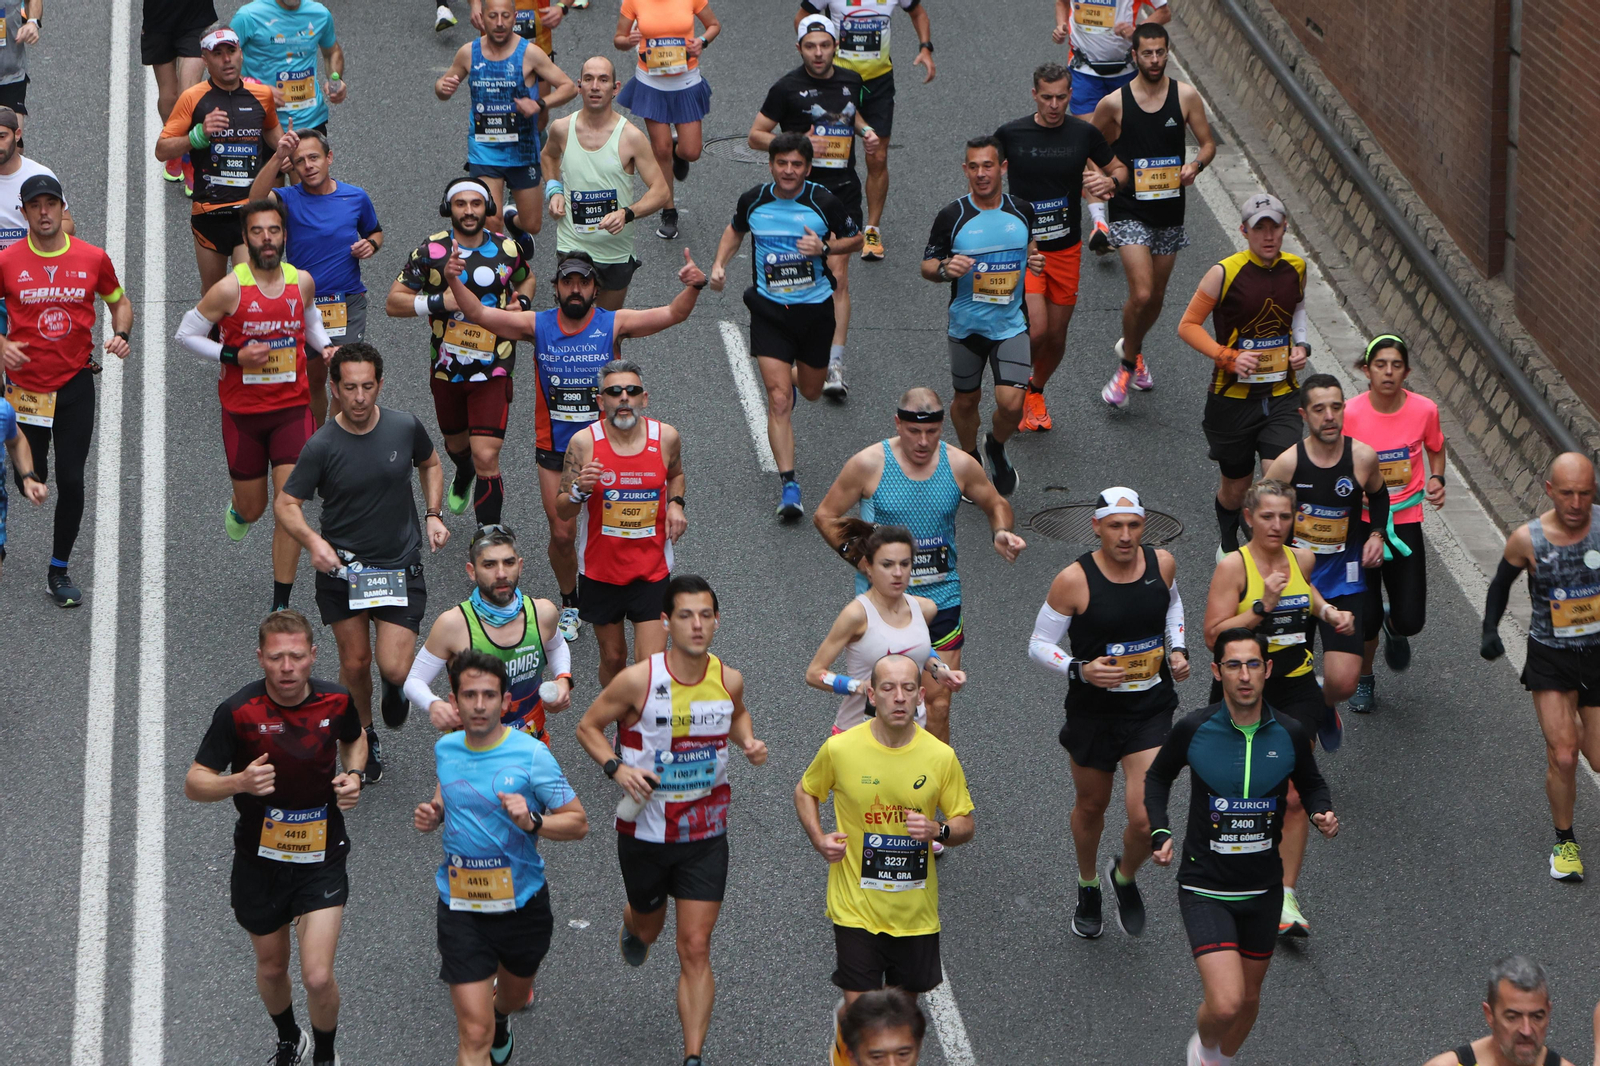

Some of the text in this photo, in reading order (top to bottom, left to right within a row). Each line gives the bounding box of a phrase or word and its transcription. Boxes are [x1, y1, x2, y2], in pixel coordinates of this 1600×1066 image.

[291, 70, 311, 79] ZURICH
[226, 160, 243, 168] 3282
[1036, 200, 1063, 210] ZURICH
[585, 206, 602, 214] 3015
[1038, 215, 1055, 224] 3244
[779, 254, 807, 262] ZURICH
[20, 287, 86, 299] ISBILYA
[463, 328, 481, 338] 4479
[460, 340, 478, 349] ANGEL
[547, 342, 598, 353] FUNDACIÓN
[1256, 338, 1284, 348] ZURICH
[562, 352, 609, 363] CARRERAS
[542, 364, 563, 373] Contra
[573, 364, 602, 373] leucemi
[1378, 452, 1404, 460] URICH
[621, 508, 641, 516] 4507
[367, 577, 388, 586] 2440
[363, 588, 388, 598] RAMÓN
[1128, 639, 1158, 652] ZURICH
[1128, 659, 1147, 669] 3841
[677, 750, 710, 762] ZURICH
[288, 811, 321, 822] ZURICH
[1231, 820, 1254, 828] 2400
[284, 830, 307, 839] 4418
[1240, 833, 1265, 842] GÓMEZ
[277, 842, 311, 851] CASTIVET
[886, 838, 922, 847] ZURICH
[466, 858, 502, 868] ZURICH
[884, 856, 908, 866] 3237
[878, 871, 912, 880] KAL_GRA
[467, 877, 489, 886] 4415
